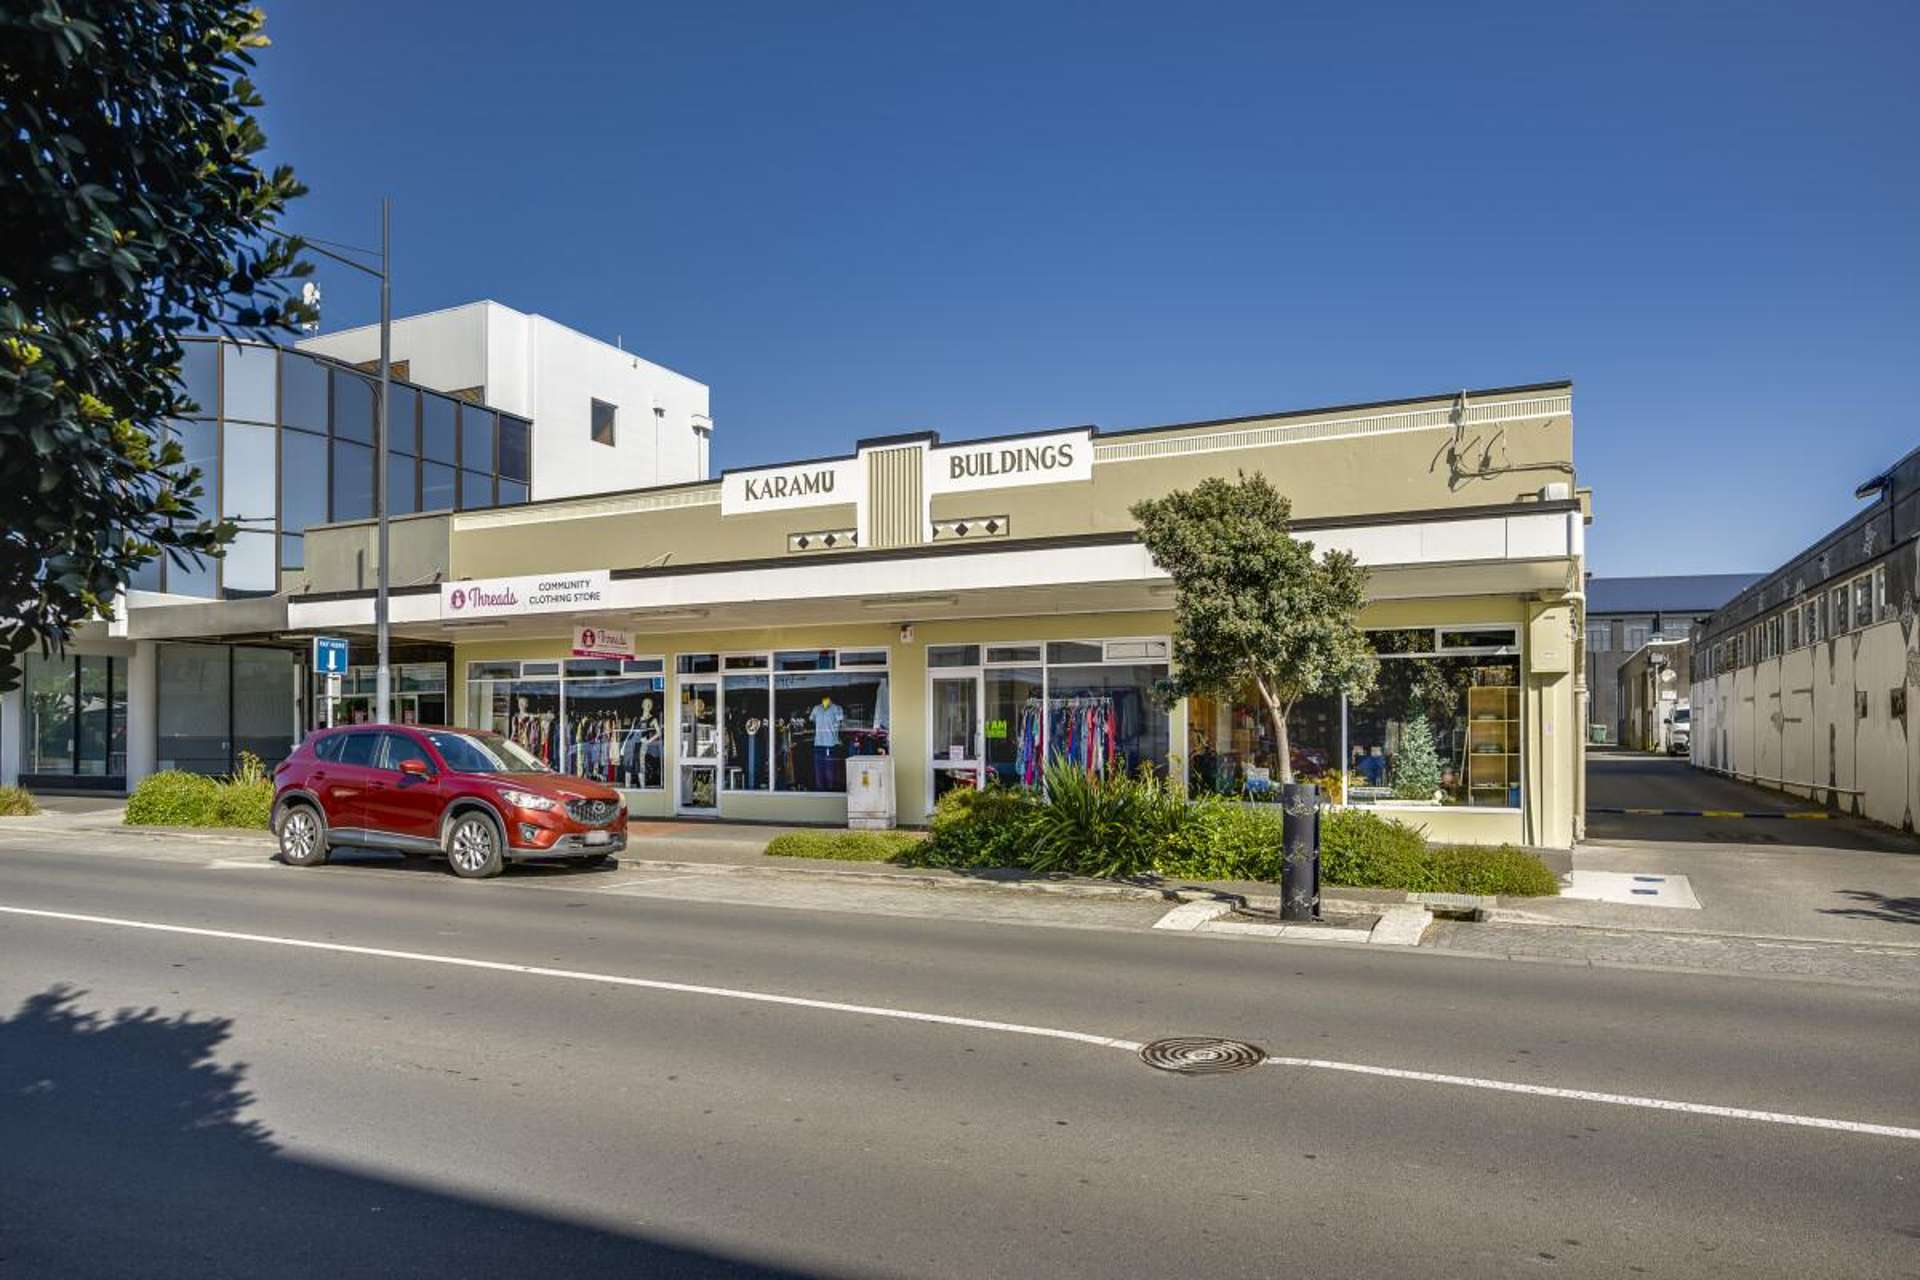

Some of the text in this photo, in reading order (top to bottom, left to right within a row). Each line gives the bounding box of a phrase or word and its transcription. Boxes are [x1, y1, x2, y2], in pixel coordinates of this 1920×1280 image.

[744, 443, 1073, 501] KARAMU BUILDINGS
[538, 579, 591, 591] COMMUNITY
[468, 586, 518, 608] Threads
[529, 591, 601, 605] CLOTHING STORE
